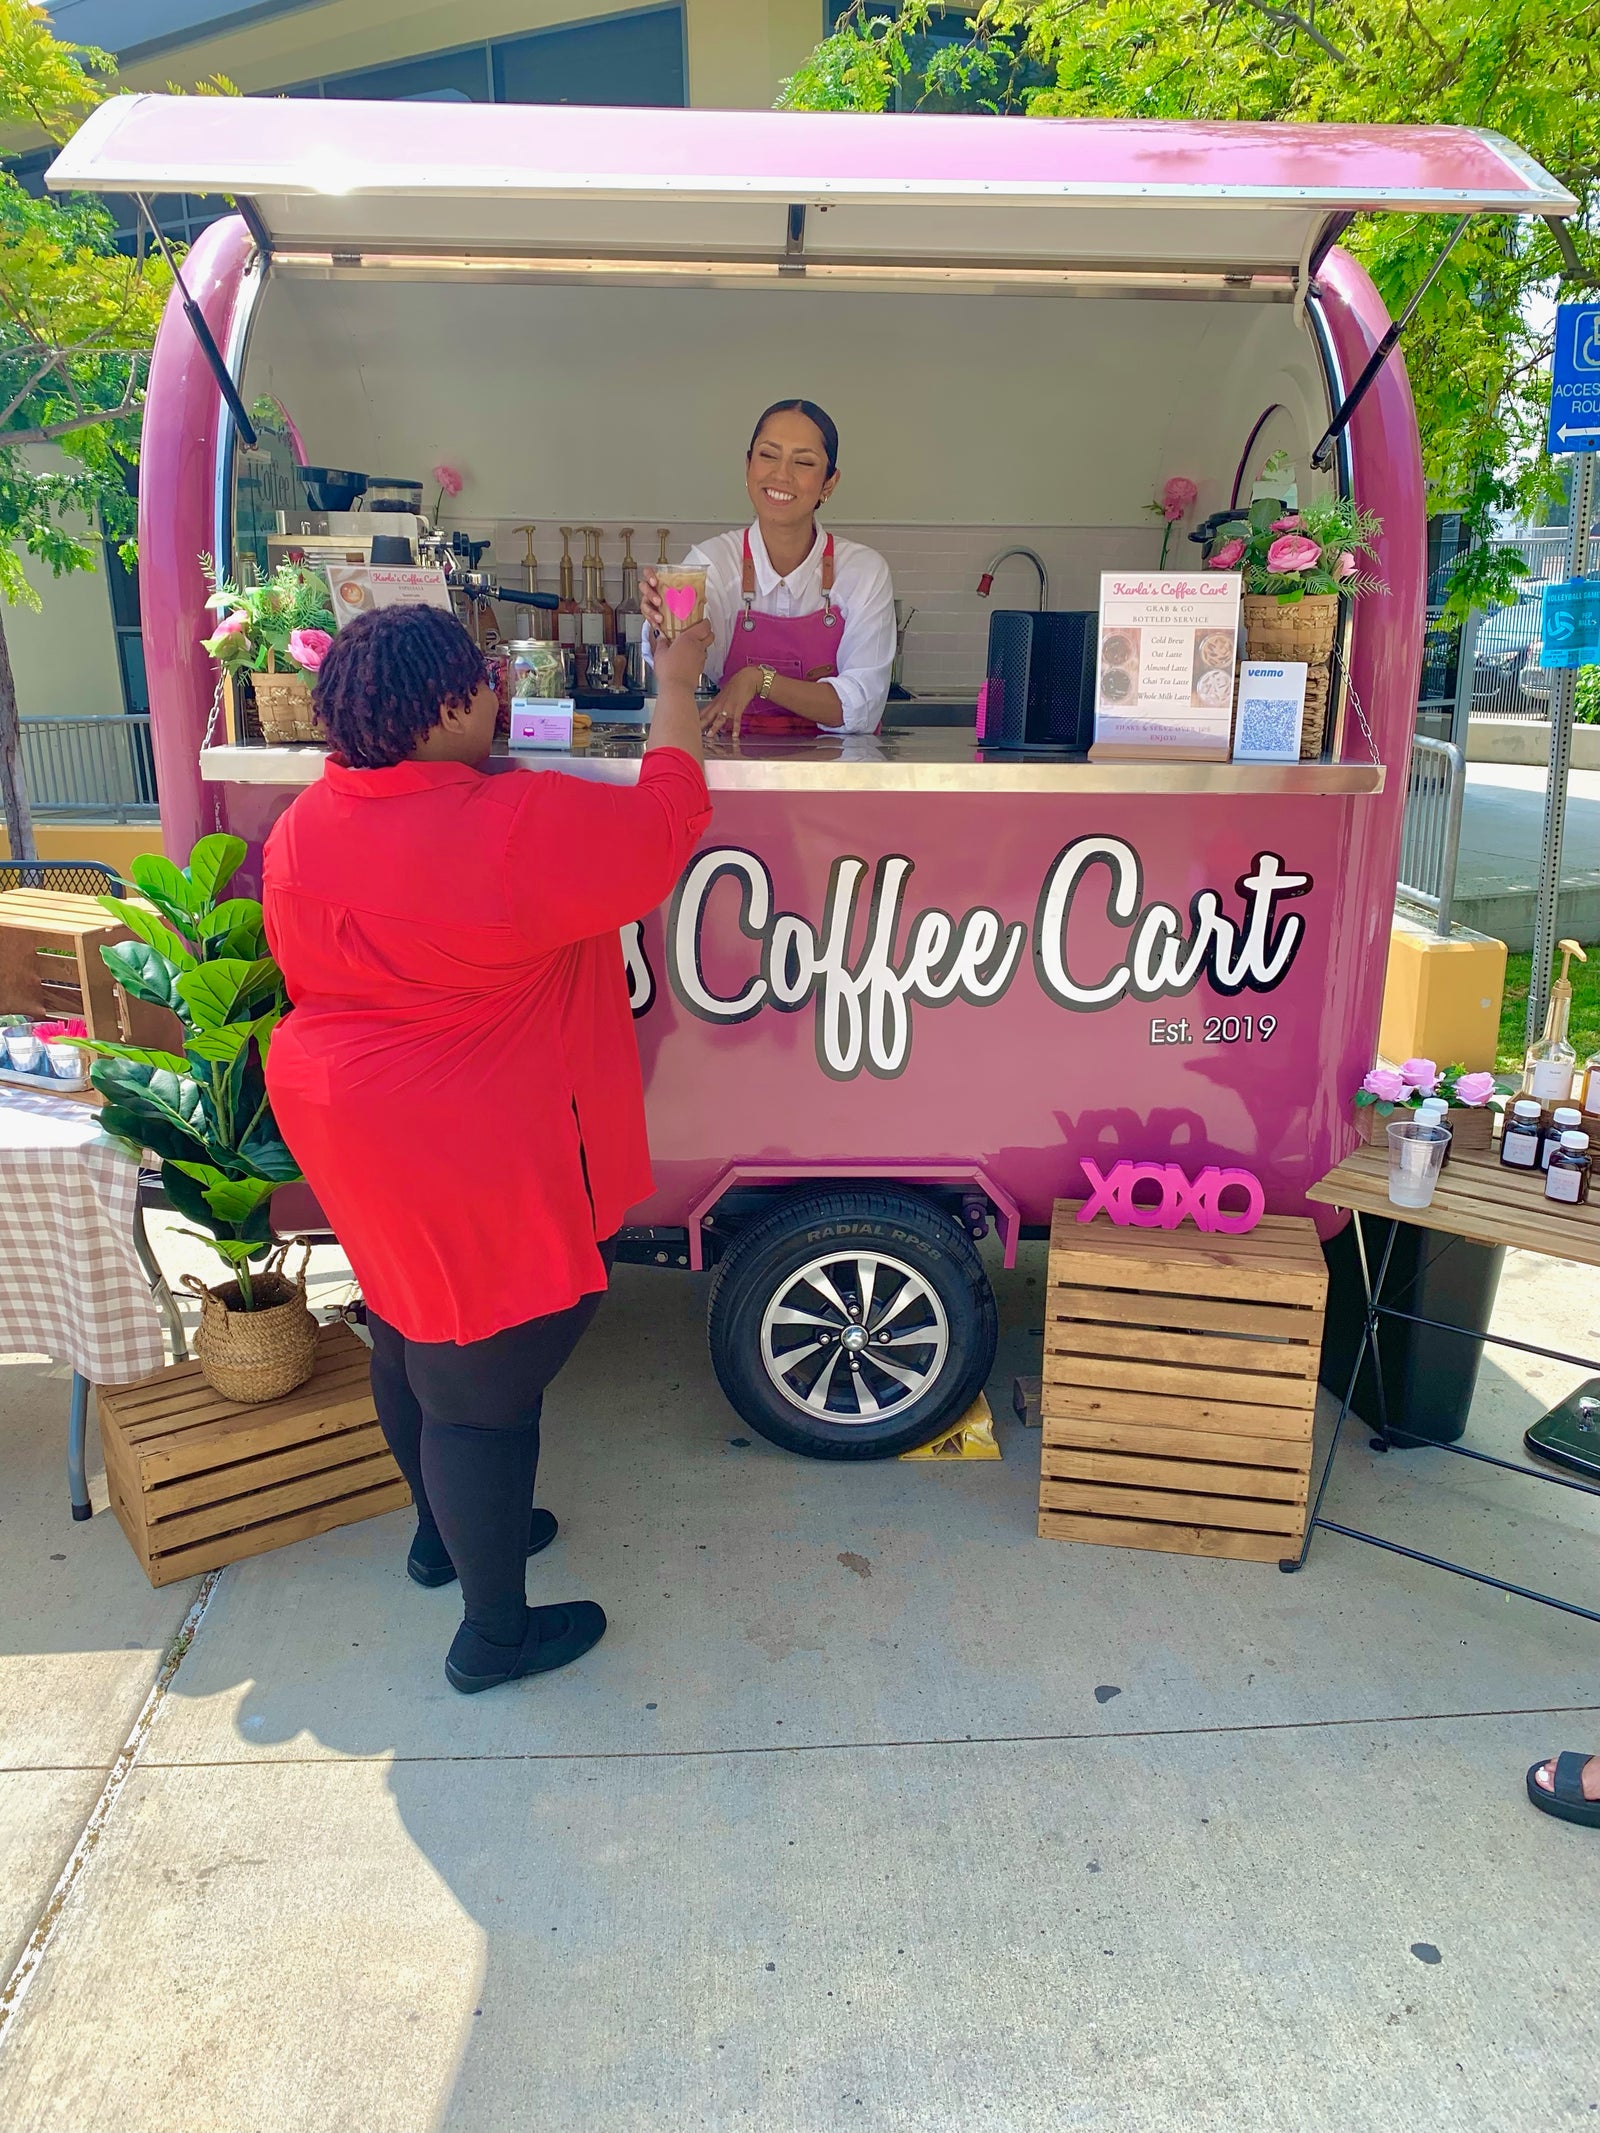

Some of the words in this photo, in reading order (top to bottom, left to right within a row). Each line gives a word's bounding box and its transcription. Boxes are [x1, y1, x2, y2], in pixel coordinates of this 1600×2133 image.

[1554, 382, 1600, 397] ACCES
[401, 573, 424, 584] Coffee
[424, 575, 441, 583] Cart
[1113, 582, 1159, 596] Karla's
[1160, 583, 1197, 600] Coffee
[1199, 583, 1228, 596] Cart
[1145, 605, 1170, 613] GRAB
[1180, 605, 1194, 613] GO
[1151, 636, 1166, 644] Cold
[1165, 650, 1183, 658] Latte
[1144, 664, 1170, 672] Almond
[1170, 664, 1188, 672] Latte
[1248, 669, 1284, 677] venmo
[1142, 677, 1158, 685] Chai
[1138, 692, 1157, 700] Whole
[1157, 692, 1174, 700] Milk
[1173, 693, 1191, 701] Latte
[668, 846, 1027, 1080] Coffee
[1035, 834, 1312, 1012] Cart
[1150, 1018, 1192, 1044] Est.
[1204, 1016, 1277, 1043] 2019
[1076, 1157, 1265, 1234] XOXO
[807, 1223, 884, 1242] RADIAL
